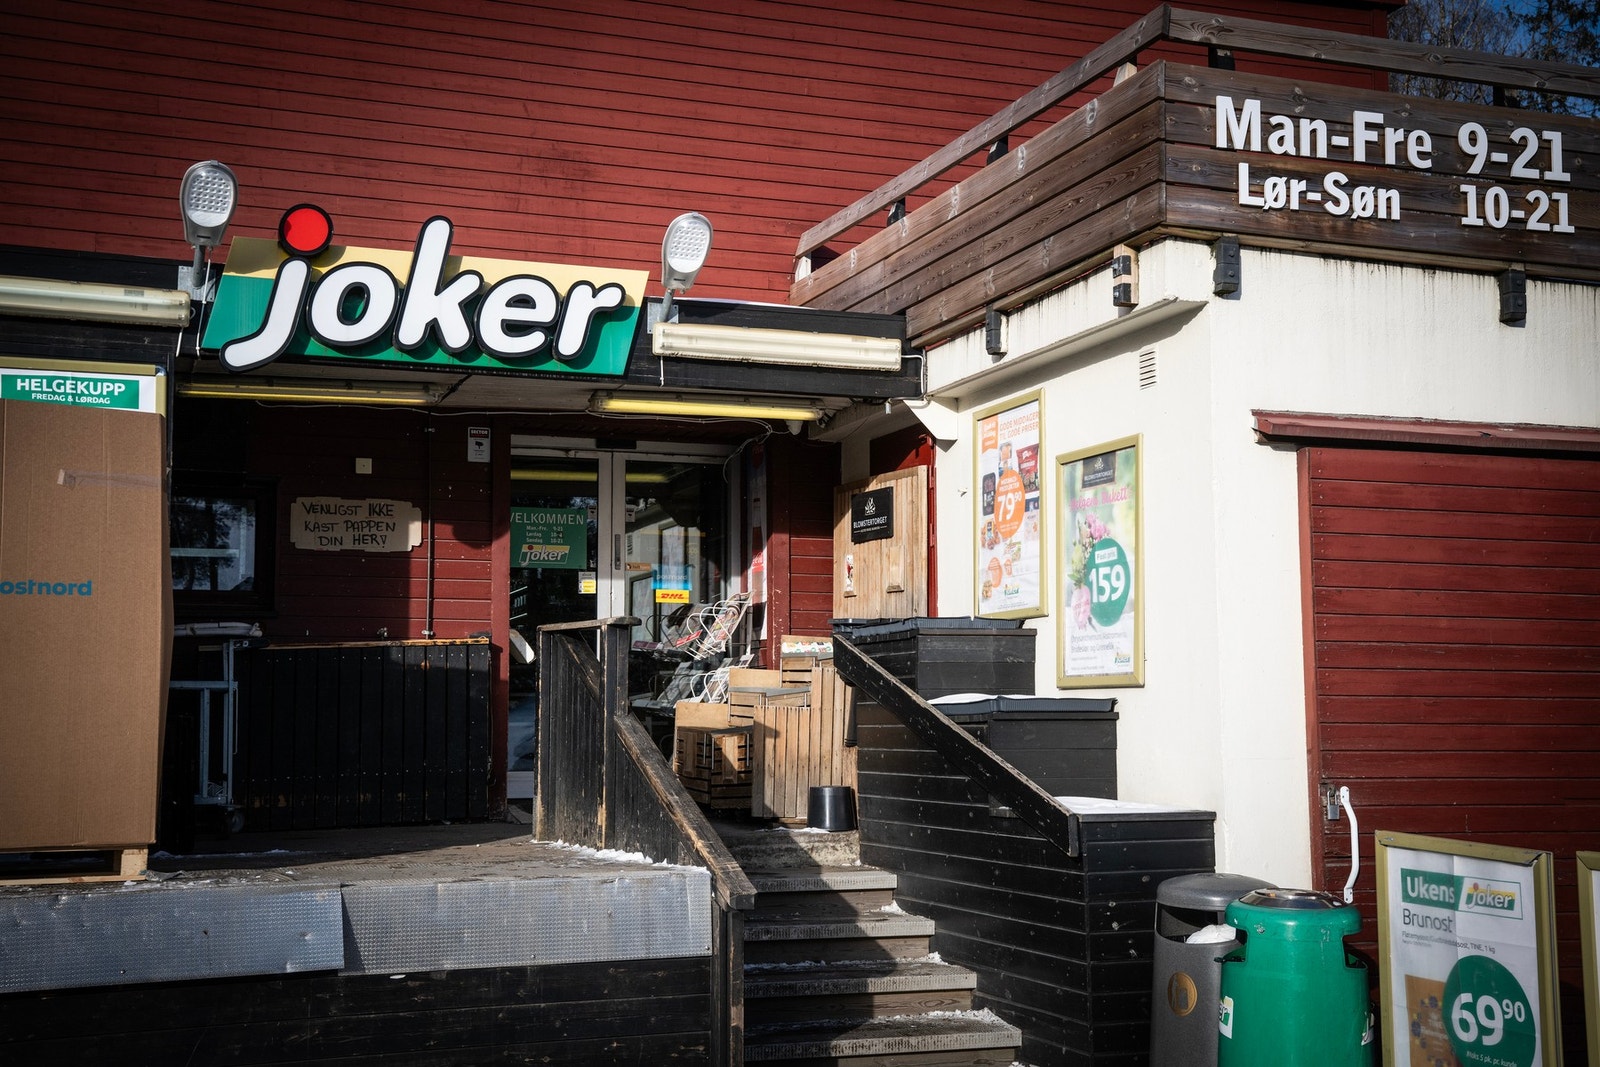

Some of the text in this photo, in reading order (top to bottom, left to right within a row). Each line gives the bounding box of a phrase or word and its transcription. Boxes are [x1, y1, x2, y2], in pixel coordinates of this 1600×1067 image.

[1215, 95, 1571, 182] Man-Fre 9-21
[1238, 162, 1575, 233] Lør-Søn 10-21
[219, 203, 627, 372] joker
[16, 378, 126, 396] HELGEKUPP
[31, 392, 111, 405] FREDAG & LØRDAG
[301, 501, 395, 517] VENLIGST IKKE
[304, 520, 396, 533] KAST PAPPEN
[317, 535, 344, 546] DIN
[520, 544, 566, 567] joker
[0, 579, 93, 597] ostnord
[1089, 564, 1126, 603] 159
[660, 592, 685, 600] DHL
[1406, 875, 1455, 904] Ukens
[1467, 882, 1514, 909] joker
[1402, 908, 1453, 933] Brunost
[1489, 946, 1496, 954] kg
